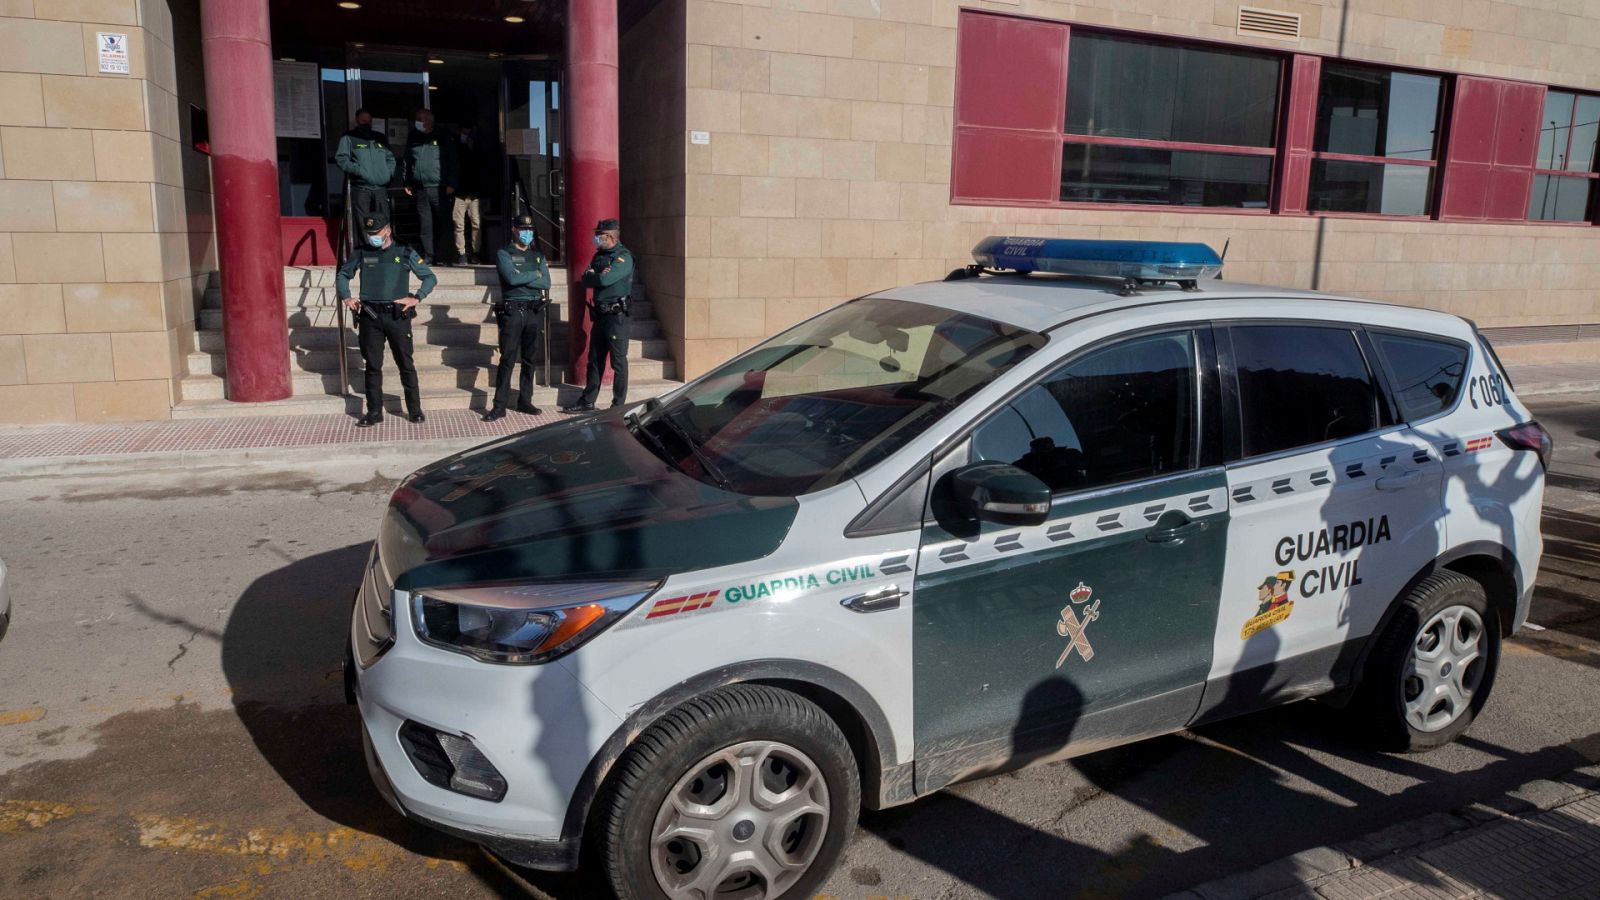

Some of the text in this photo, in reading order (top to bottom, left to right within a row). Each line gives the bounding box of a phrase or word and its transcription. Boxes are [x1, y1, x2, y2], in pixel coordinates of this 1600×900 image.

[1003, 238, 1045, 246] GUARDIA
[1004, 246, 1027, 256] CIVIL
[1274, 514, 1392, 567] GUARDIA
[725, 564, 875, 604] GUARDIA CIVIL
[1300, 559, 1363, 598] CIVIL
